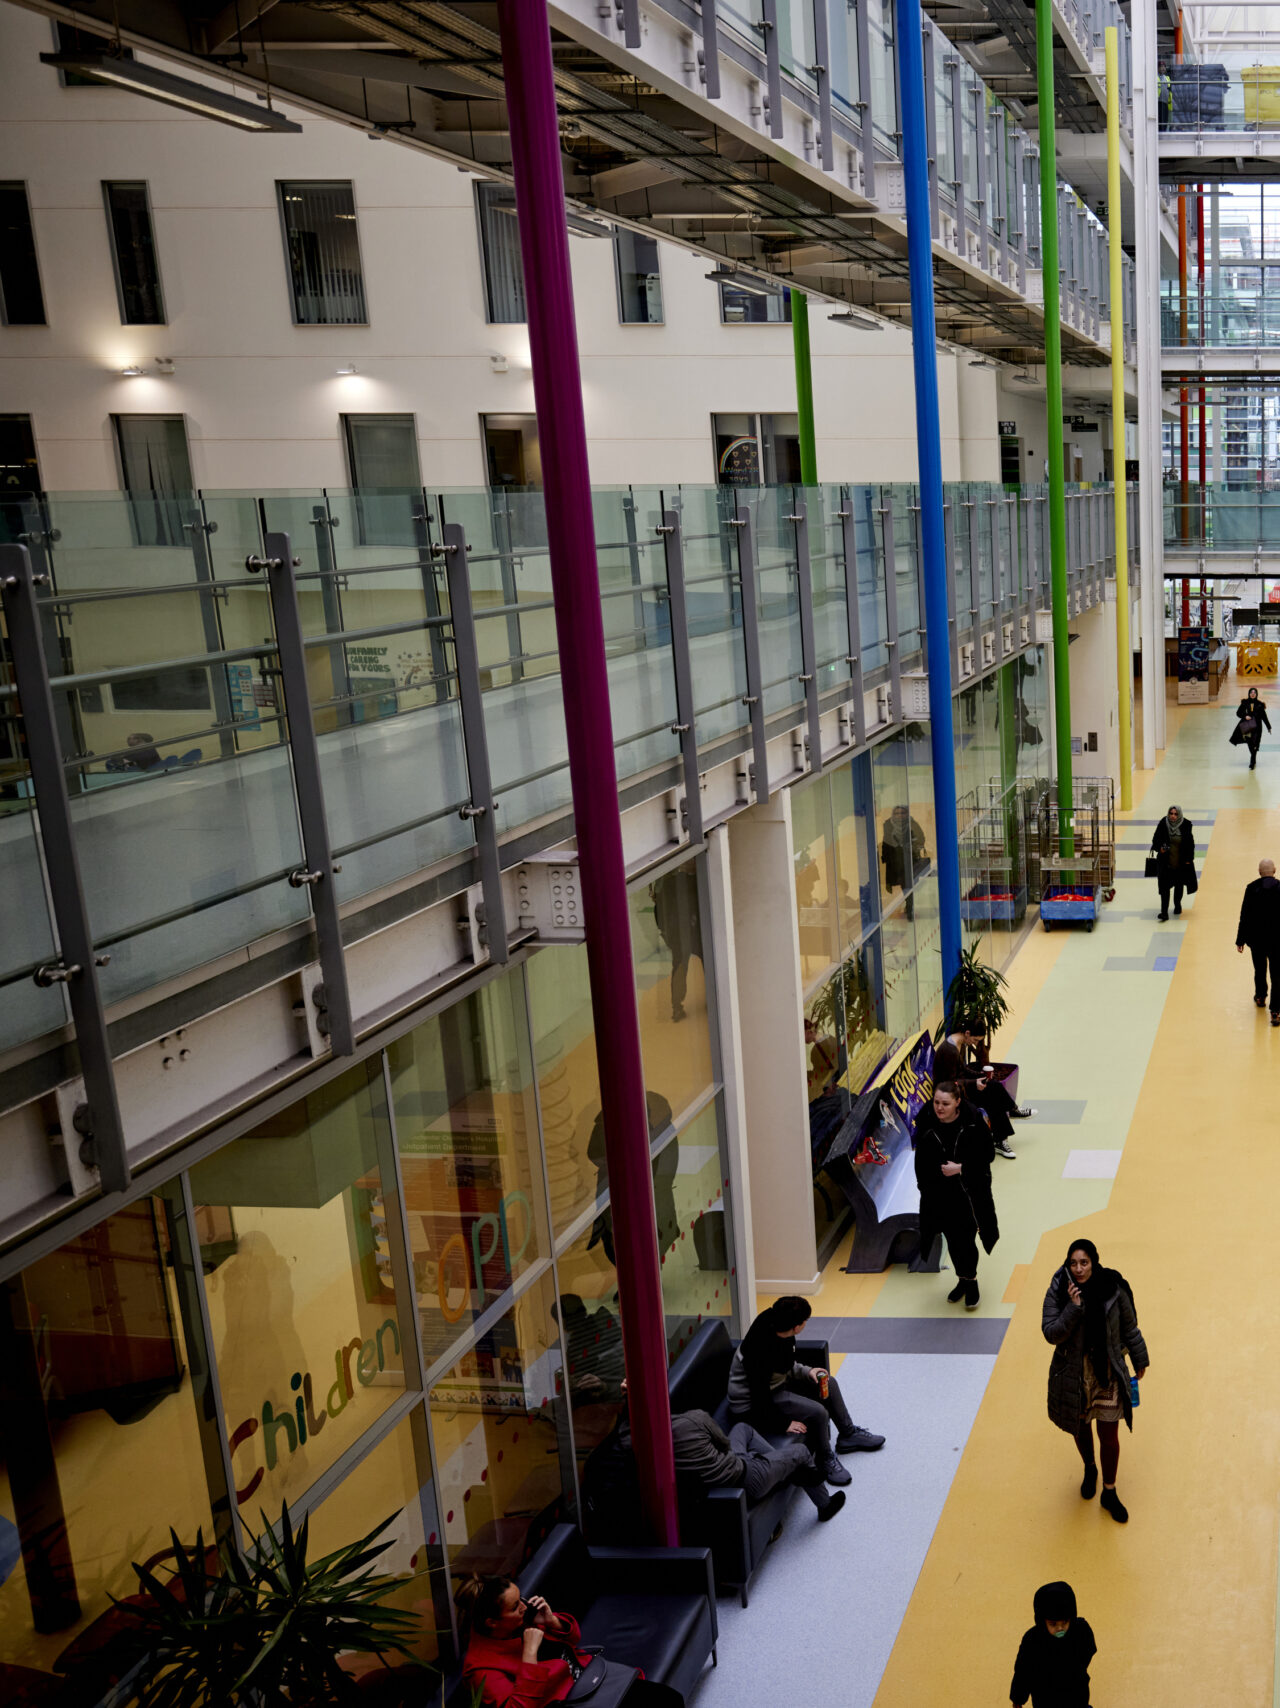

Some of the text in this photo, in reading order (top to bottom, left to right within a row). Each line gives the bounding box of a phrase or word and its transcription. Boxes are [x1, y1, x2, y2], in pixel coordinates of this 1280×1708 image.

[361, 664, 390, 672] YOURS
[890, 1055, 919, 1114] LOOK
[229, 1317, 401, 1504] Children
